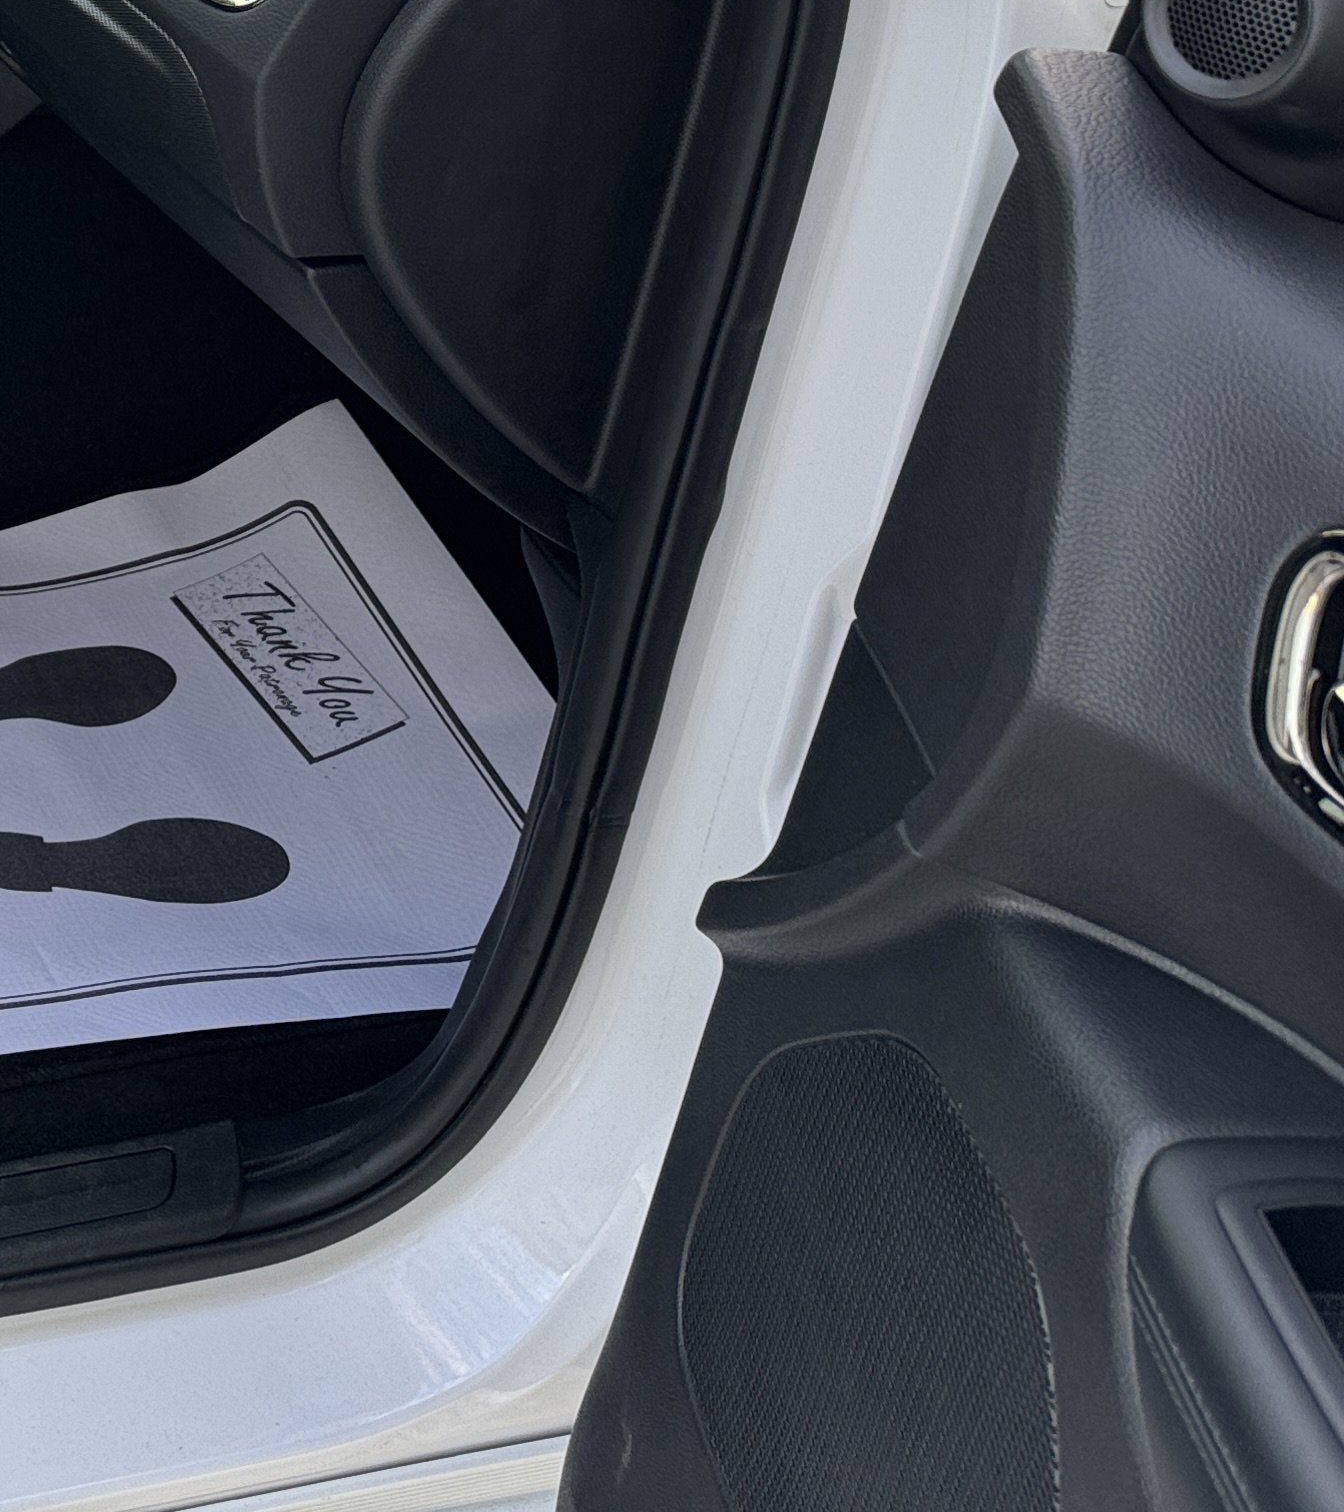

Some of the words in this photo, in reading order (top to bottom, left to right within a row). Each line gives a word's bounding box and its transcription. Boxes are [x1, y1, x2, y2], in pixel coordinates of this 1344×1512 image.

[212, 620, 241, 638] For
[230, 639, 257, 663] Your
[222, 581, 341, 671] Thank
[302, 676, 375, 727] You
